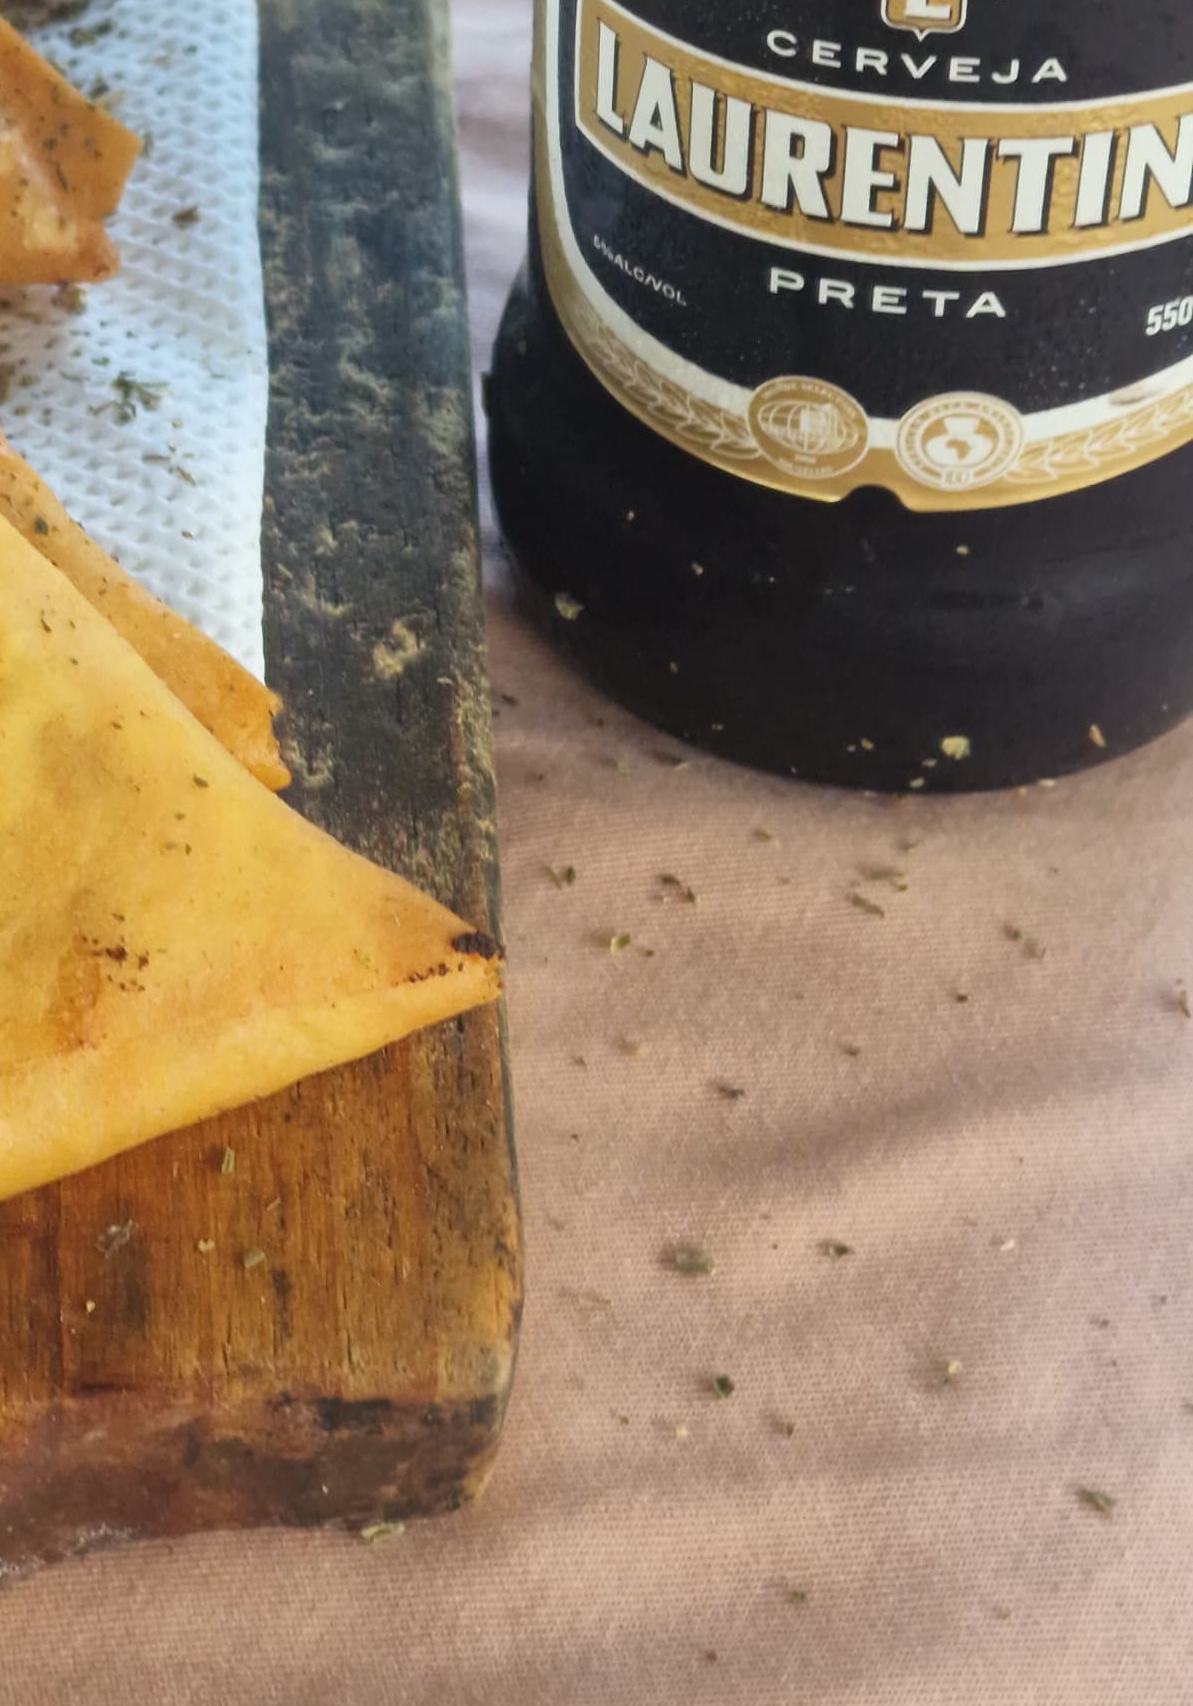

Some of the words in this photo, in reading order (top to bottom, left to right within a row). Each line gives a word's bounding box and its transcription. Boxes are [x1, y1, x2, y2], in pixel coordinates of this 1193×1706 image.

[766, 29, 1068, 85] CERVEJA
[592, 17, 1193, 238] LAURENTIN
[768, 268, 1007, 319] PRETA
[1145, 294, 1193, 337] 550
